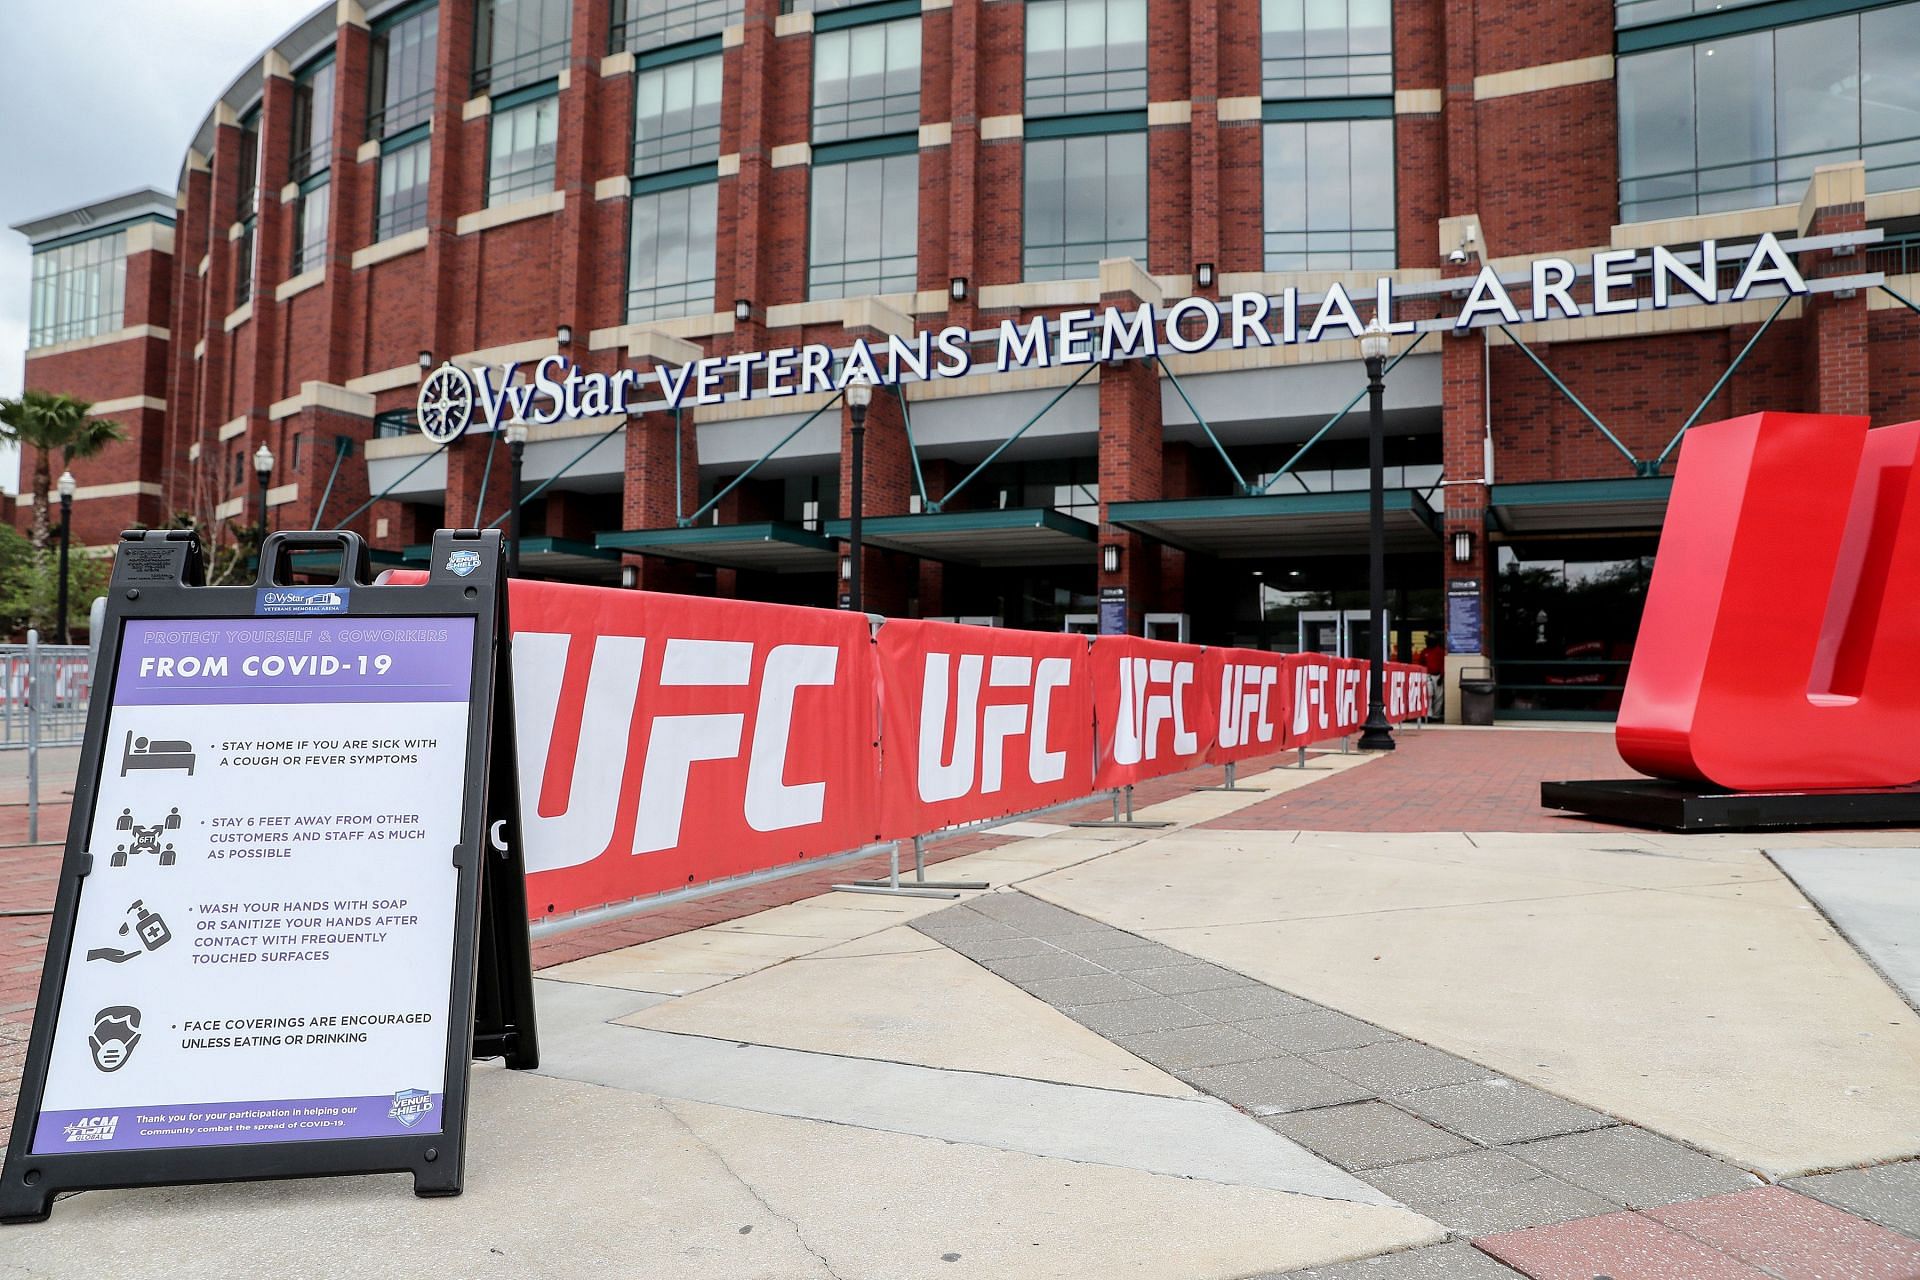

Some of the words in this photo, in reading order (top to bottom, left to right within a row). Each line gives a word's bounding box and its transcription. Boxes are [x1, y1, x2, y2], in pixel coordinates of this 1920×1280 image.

[472, 354, 636, 430] VyStar
[655, 326, 970, 408] VETERANS
[997, 277, 1416, 372] MEMORIAL
[1455, 231, 1810, 329] ARENA
[276, 592, 304, 604] VyStar
[144, 631, 220, 644] PROTECT
[226, 630, 312, 643] YOURSELF
[318, 630, 332, 642] &
[338, 629, 448, 642] COWORKERS
[140, 656, 228, 678] FROM
[242, 654, 392, 677] COVID-19
[1219, 664, 1277, 748] UFC
[1293, 664, 1328, 736] UFC
[1114, 657, 1197, 765] UFC
[918, 652, 1071, 803] UFC
[222, 741, 252, 751] STAY
[256, 741, 293, 750] HOME
[297, 741, 309, 750] IF
[313, 740, 339, 750] YOU
[343, 740, 368, 749] ARE
[372, 740, 400, 749] SICK
[404, 739, 437, 748] WITH
[220, 757, 228, 766] A
[233, 757, 278, 766] COUGH
[283, 756, 301, 765] OR
[305, 756, 346, 765] FEVER
[350, 755, 418, 764] SYMPTOMS
[512, 632, 839, 874] UFC
[212, 818, 243, 827] STAY
[247, 817, 254, 826] 6
[259, 817, 291, 826] FEET
[294, 816, 332, 825] AWAY
[335, 816, 372, 825] FROM
[376, 814, 419, 824] OTHER
[139, 836, 154, 844] 6FT
[210, 833, 288, 843] CUSTOMERS
[293, 832, 321, 841] AND
[325, 831, 365, 841] STAFF
[368, 831, 385, 840] AS
[388, 830, 426, 839] MUCH
[208, 849, 225, 859] AS
[229, 848, 291, 858] POSSIBLE
[199, 903, 239, 914] WASH
[243, 903, 280, 913] YOUR
[283, 902, 329, 912] HANDS
[333, 901, 368, 910] WITH
[371, 900, 407, 910] SOAP
[196, 921, 216, 931] OR
[220, 919, 281, 930] SANITIZE
[285, 918, 322, 928] YOUR
[326, 917, 371, 927] HANDS
[375, 915, 418, 926] AFTER
[194, 936, 258, 947] CONTACT
[262, 935, 297, 945] WITH
[301, 932, 387, 944] FREQUENTLY
[192, 953, 257, 964] TOUCHED
[261, 951, 330, 962] SURFACES
[184, 1020, 221, 1032] FACE
[225, 1017, 305, 1030] COVERINGS
[309, 1017, 337, 1027] ARE
[341, 1013, 432, 1026] ENCOURAGED
[182, 1038, 230, 1049] UNLESS
[234, 1035, 281, 1047] EATING
[284, 1035, 303, 1045] OR
[306, 1032, 367, 1044] DRINKING
[390, 1103, 432, 1116] SHIELD
[393, 1096, 430, 1108] VENUE
[136, 1115, 166, 1124] Thank
[168, 1116, 186, 1124] you
[188, 1112, 202, 1121] for
[205, 1113, 227, 1122] your
[229, 1106, 290, 1120] participation
[304, 1106, 338, 1117] helping
[342, 1106, 358, 1114] our
[71, 1116, 119, 1135] ASM
[140, 1126, 195, 1136] Community
[198, 1124, 233, 1133] combat
[236, 1123, 250, 1131] the
[254, 1122, 284, 1131] spread
[288, 1121, 298, 1129] of
[300, 1120, 346, 1128] COVID-19.
